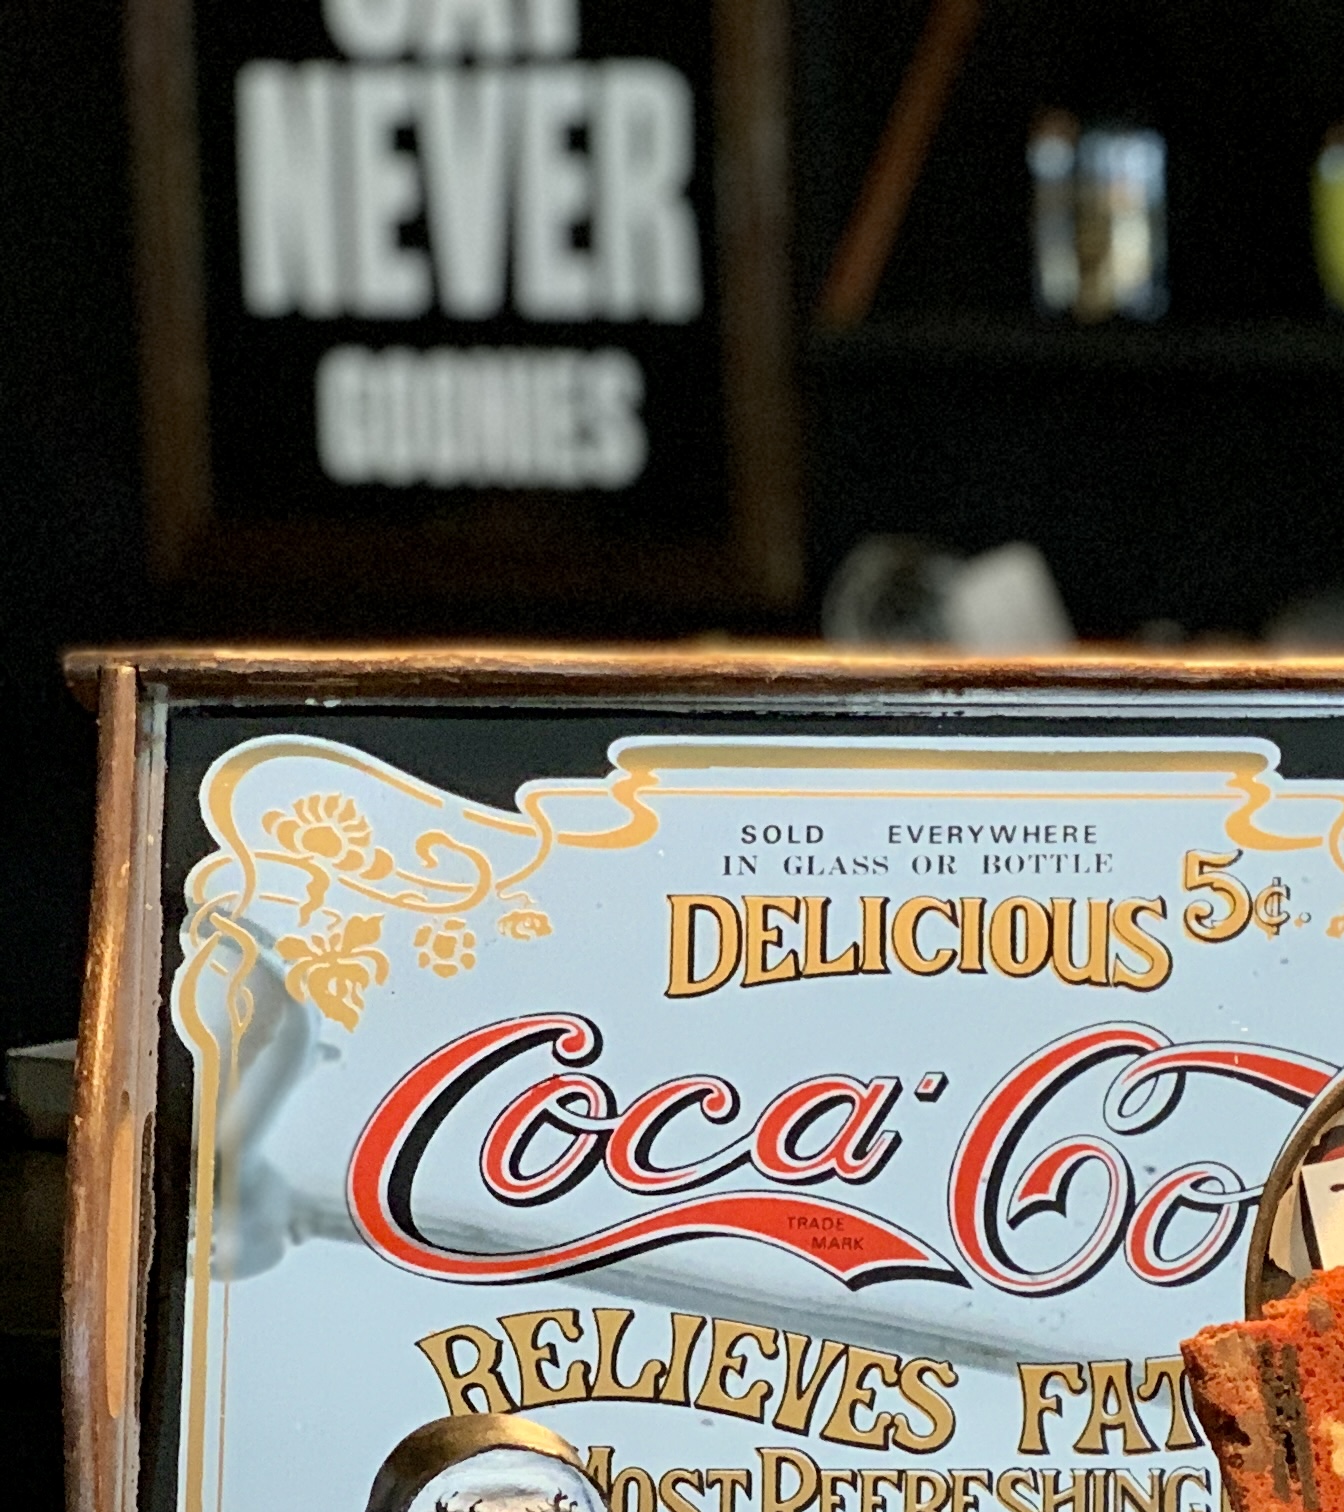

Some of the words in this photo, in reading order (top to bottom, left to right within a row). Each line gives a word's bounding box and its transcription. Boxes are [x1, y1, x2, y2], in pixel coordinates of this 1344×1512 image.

[236, 58, 703, 323] NEVER
[741, 825, 825, 845] SOLD
[888, 825, 1098, 845] EVERYWHERE
[722, 855, 758, 876] IN
[784, 855, 889, 876] GLASS
[912, 854, 957, 875] OR
[982, 853, 1113, 875] BOTTLE
[666, 892, 1173, 1000] DELICIOUS
[788, 1216, 844, 1231] TRADE
[811, 1236, 864, 1250] MARK
[415, 1307, 958, 1455] RELIEVES
[1017, 1354, 1205, 1456] FAT
